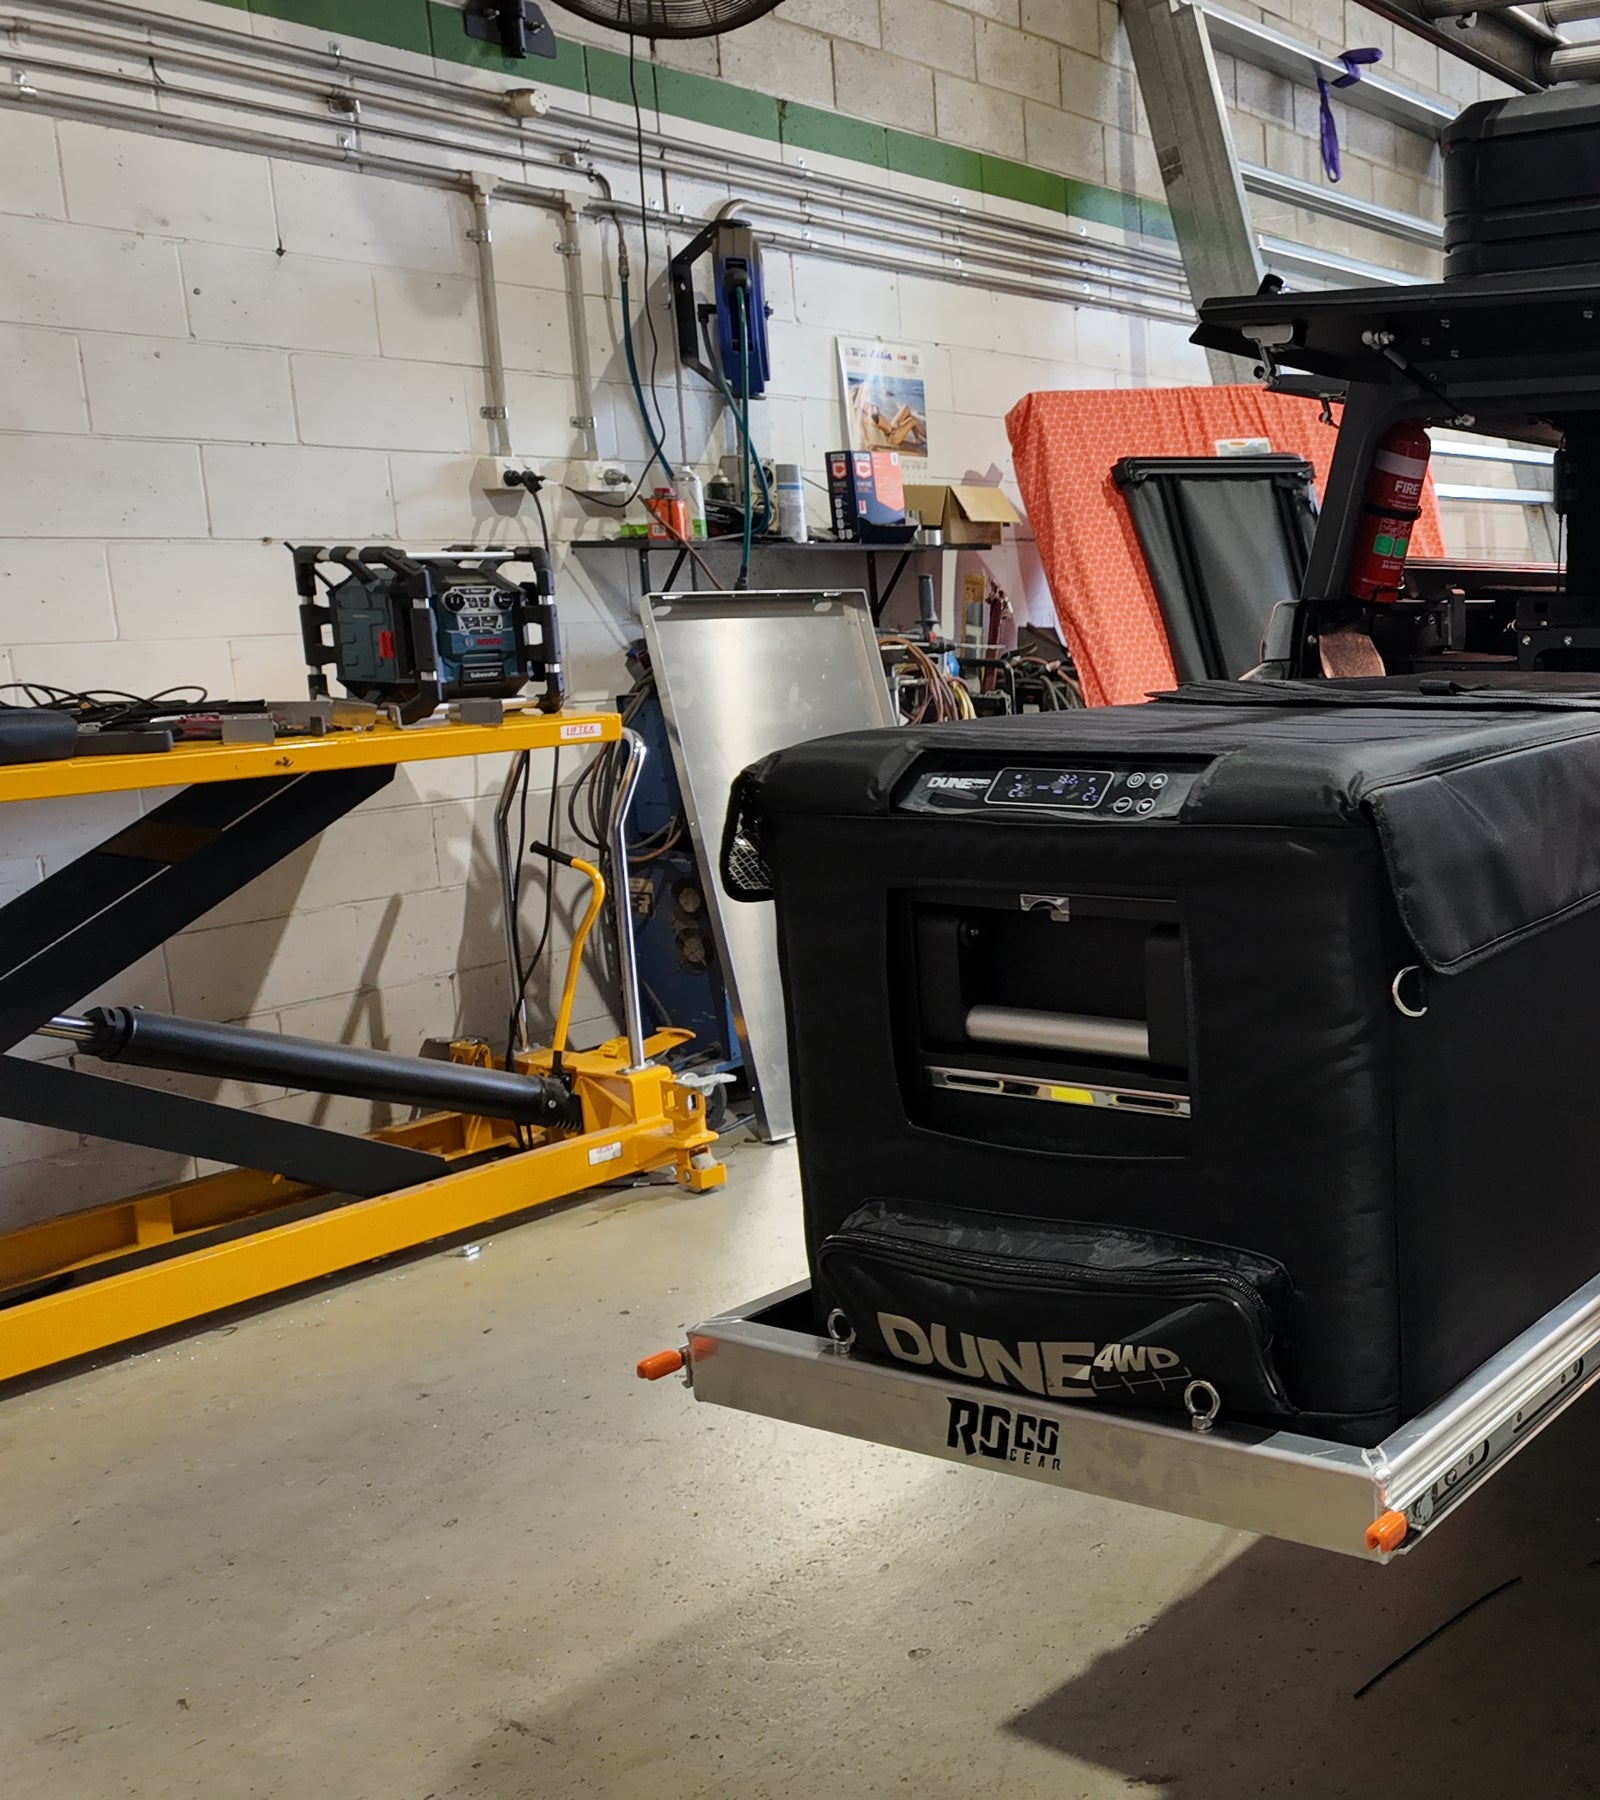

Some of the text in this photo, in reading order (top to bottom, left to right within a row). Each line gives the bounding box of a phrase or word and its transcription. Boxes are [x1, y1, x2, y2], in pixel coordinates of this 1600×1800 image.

[1394, 480, 1420, 495] FIRE
[927, 777, 973, 789] DUNE
[877, 1311, 1181, 1398] DUNE 4WD
[946, 1396, 1060, 1461] ROCO
[1009, 1447, 1061, 1471] GEAR
